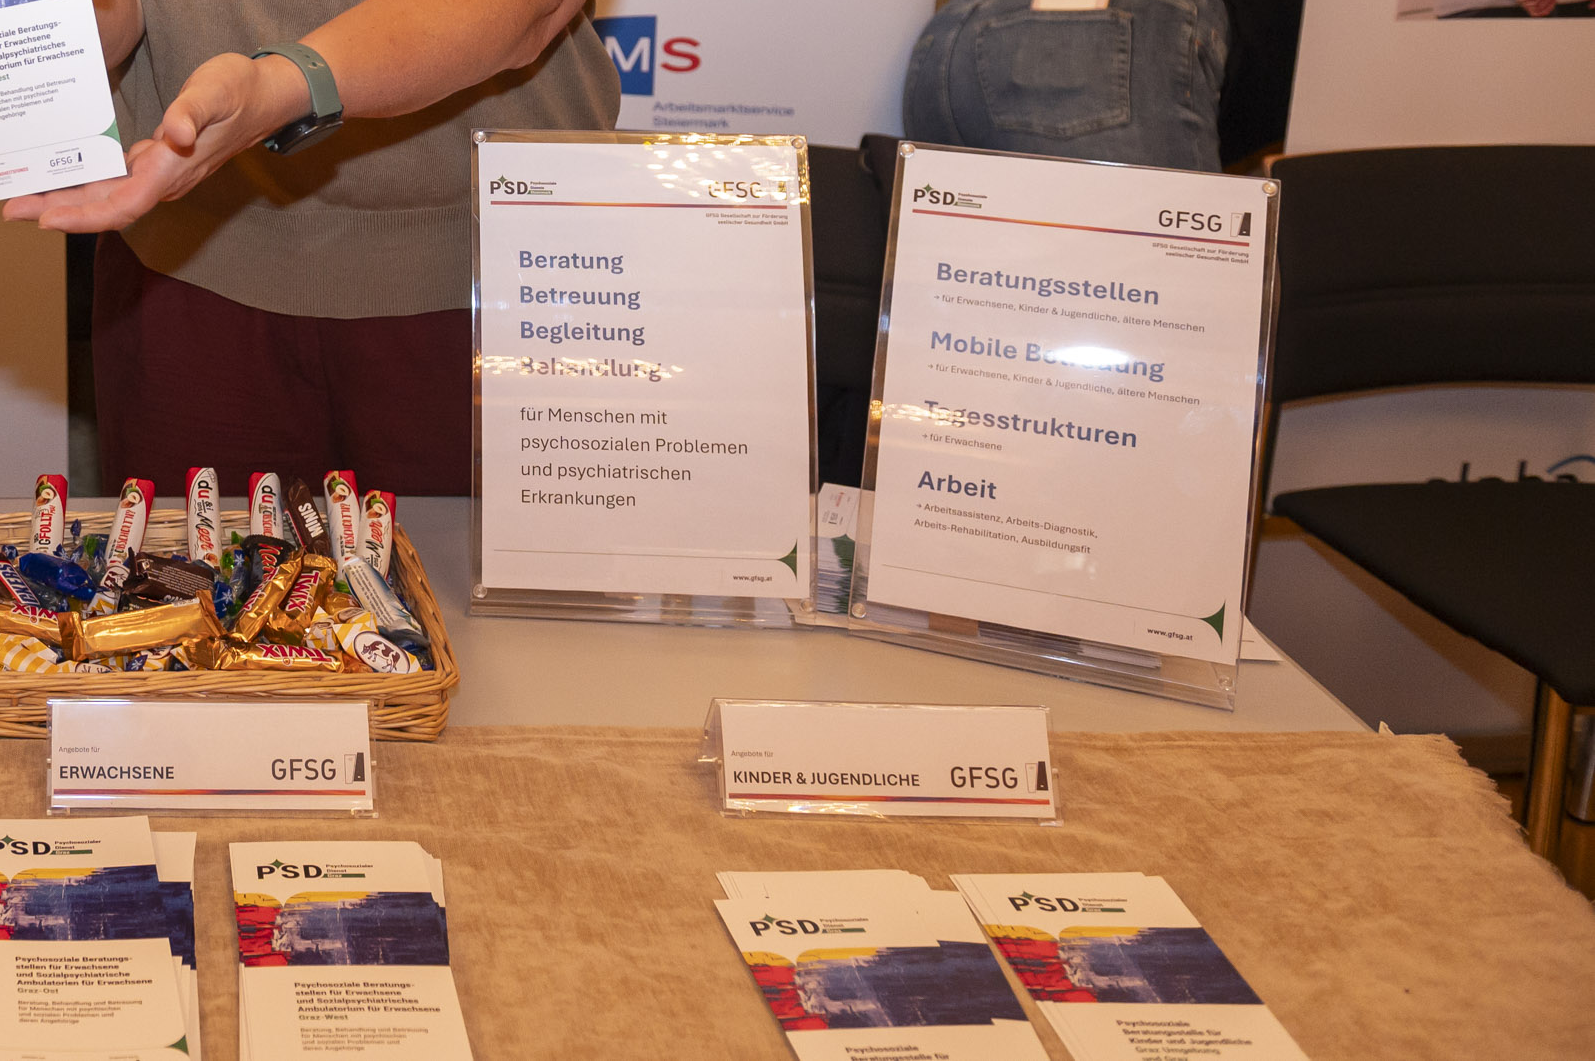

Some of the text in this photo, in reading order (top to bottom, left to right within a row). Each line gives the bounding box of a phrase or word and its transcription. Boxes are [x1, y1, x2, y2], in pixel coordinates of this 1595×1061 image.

[18, 20, 61, 34] Beratungs-
[4, 33, 51, 48] Erwachsene
[24, 57, 35, 65] für
[37, 48, 84, 63] Erwachsene
[50, 156, 72, 167] GFSG
[490, 180, 528, 196] PSD
[913, 188, 955, 206] PSD
[1158, 210, 1223, 233] GFSG
[519, 250, 623, 274] Beratung
[937, 262, 1159, 306] Beratungsstellen
[520, 286, 641, 310] Betreuung
[941, 294, 1205, 333] für Erwachsene, Kinder & Jugendliche, ältere Menschen
[521, 321, 645, 346] Begleitung
[931, 331, 1018, 360] Mobile
[936, 363, 1200, 405] für Erwachsene, Kinder & Jugendliche, ältere Menschen
[521, 407, 667, 425] für Menschen mit
[521, 436, 748, 455] psychosozialen Problemen
[930, 433, 1003, 451] für Erwachsene
[521, 464, 692, 481] und psychiatrischen
[918, 471, 997, 499] Arbeit
[521, 490, 636, 509] Erkrankungen
[298, 503, 324, 538] MINIS
[924, 502, 1098, 539] Arbeitsassistenz, Arbeits-Diagnostik,
[914, 518, 1091, 554] Arbeits-Rehabilitation, Ausbildungsfit
[733, 574, 772, 582] www.gfsg.at
[286, 570, 320, 611] TWIX
[1147, 627, 1193, 642] www.gfsg.at
[257, 644, 333, 662] TWIX
[58, 746, 89, 754] Angebote
[731, 750, 762, 758] Angebote
[59, 758, 336, 780] ERWACHSENE GFSG
[733, 766, 1018, 789] KINDER & JUGENDLICHE GFSG
[256, 865, 323, 879] PSD
[1007, 897, 1079, 912] PSD
[749, 919, 820, 936] PSD
